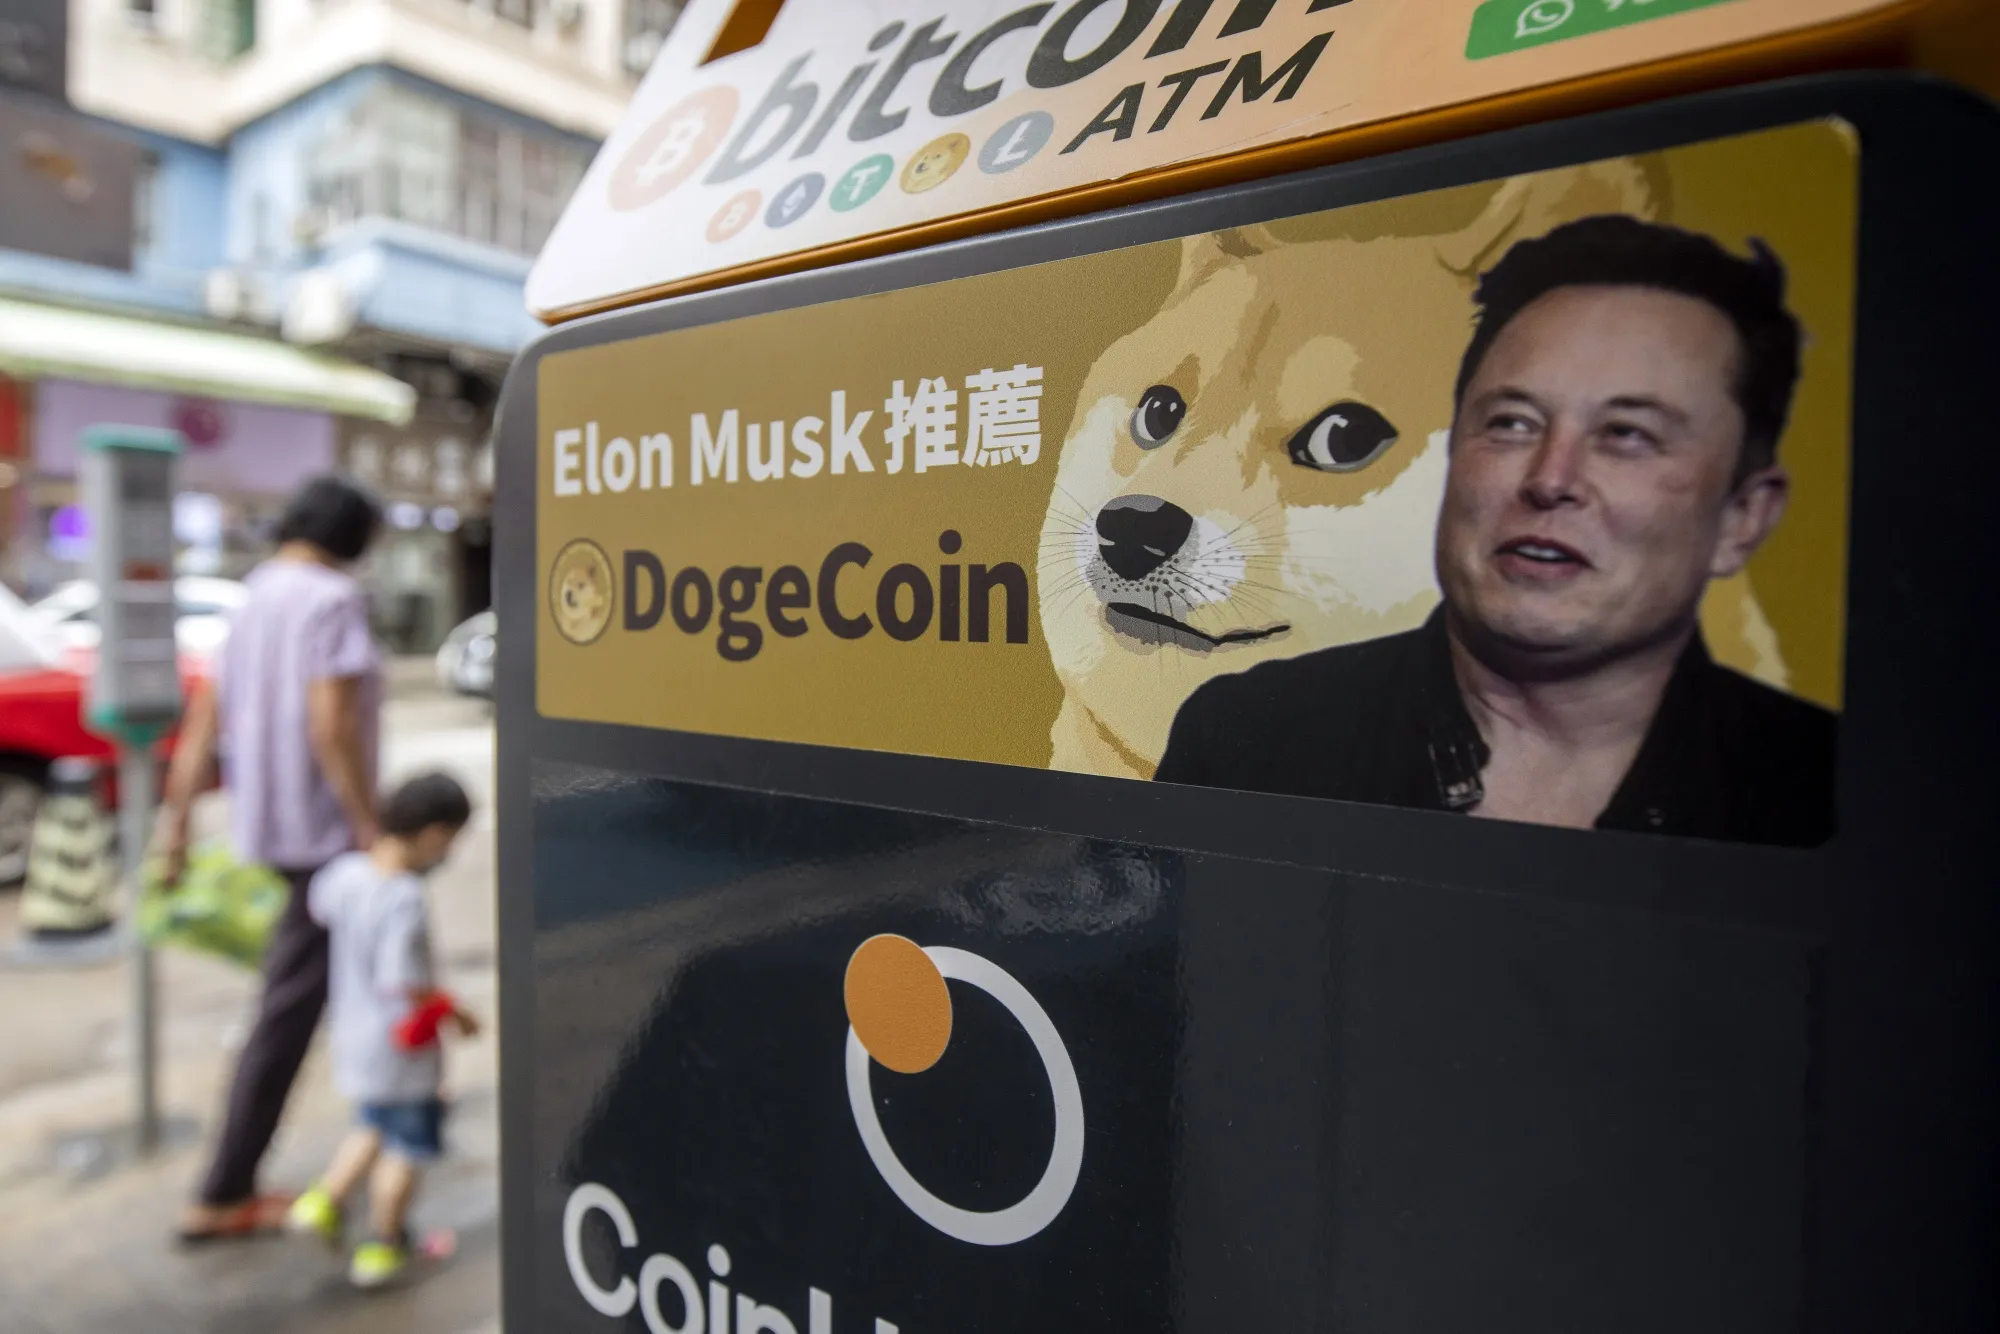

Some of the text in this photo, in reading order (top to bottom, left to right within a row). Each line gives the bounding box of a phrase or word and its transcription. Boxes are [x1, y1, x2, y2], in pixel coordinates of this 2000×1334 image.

[700, 0, 1352, 185] bitco
[1058, 31, 1336, 155] ATM
[553, 363, 1044, 497] Elon Musk 推薦
[622, 529, 1030, 662] DogeCoin
